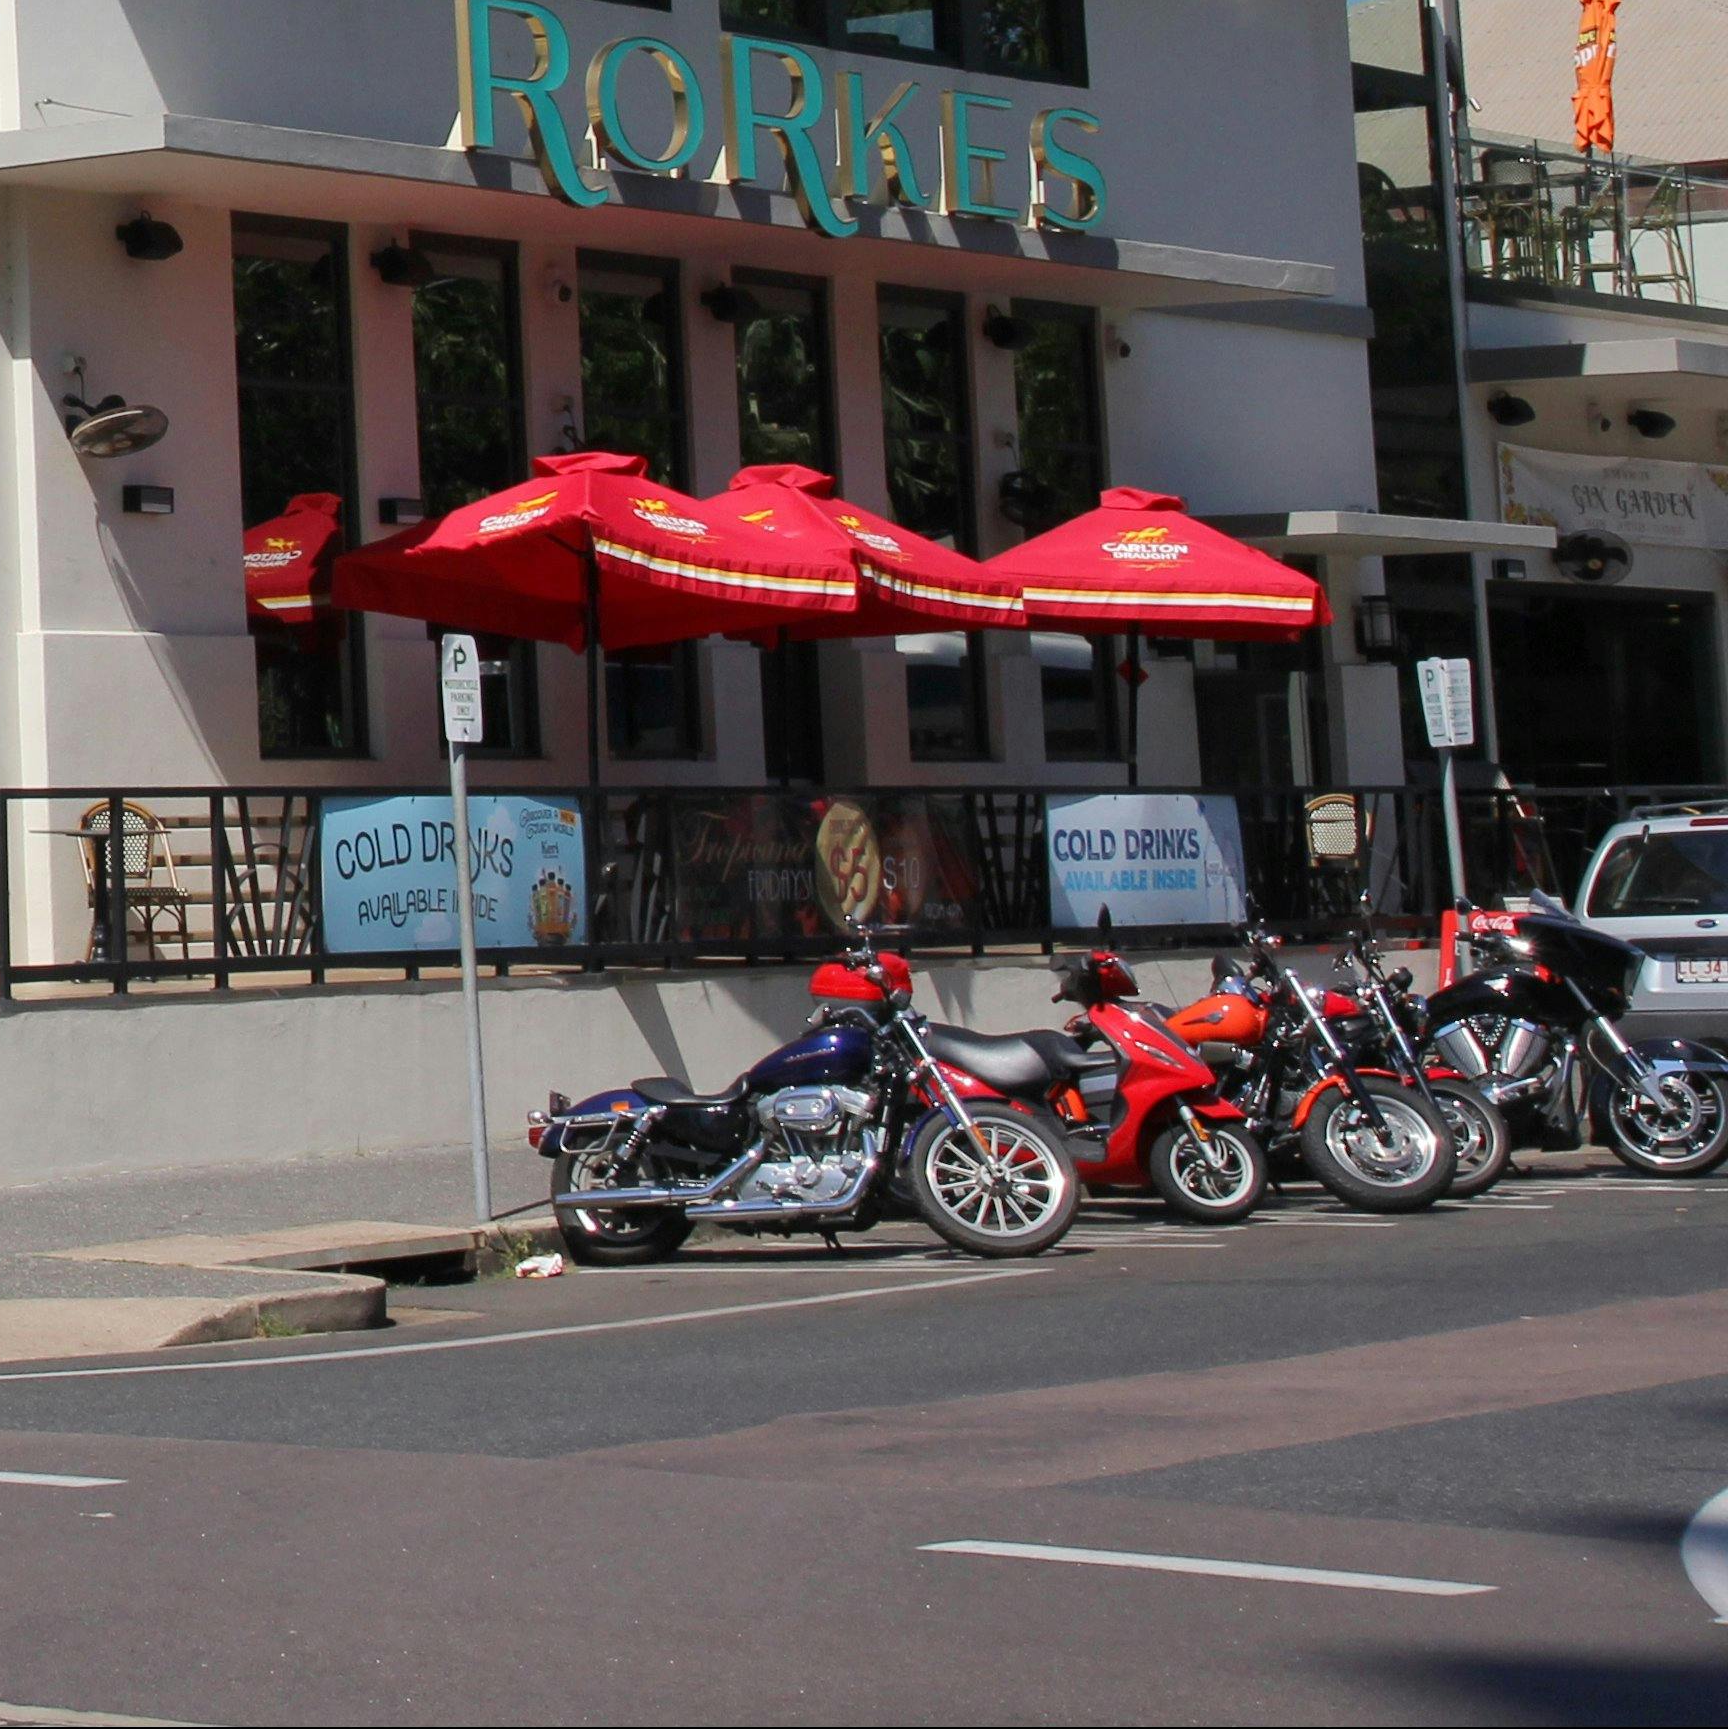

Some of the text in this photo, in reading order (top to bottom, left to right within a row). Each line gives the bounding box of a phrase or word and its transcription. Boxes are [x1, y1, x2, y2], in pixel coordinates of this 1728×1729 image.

[1571, 483, 1696, 519] GIN GARDEN
[1101, 542, 1189, 554] CARLTON
[1112, 551, 1178, 560] DRAUGHT
[453, 648, 467, 672] P
[1426, 669, 1434, 688] P
[335, 821, 514, 885] COLD DRNKS
[1053, 827, 1200, 862] COLD DRINKS
[1064, 870, 1147, 892] AVAILABLE
[1153, 869, 1197, 890] INSIDE
[358, 888, 448, 928] AVAILABLE
